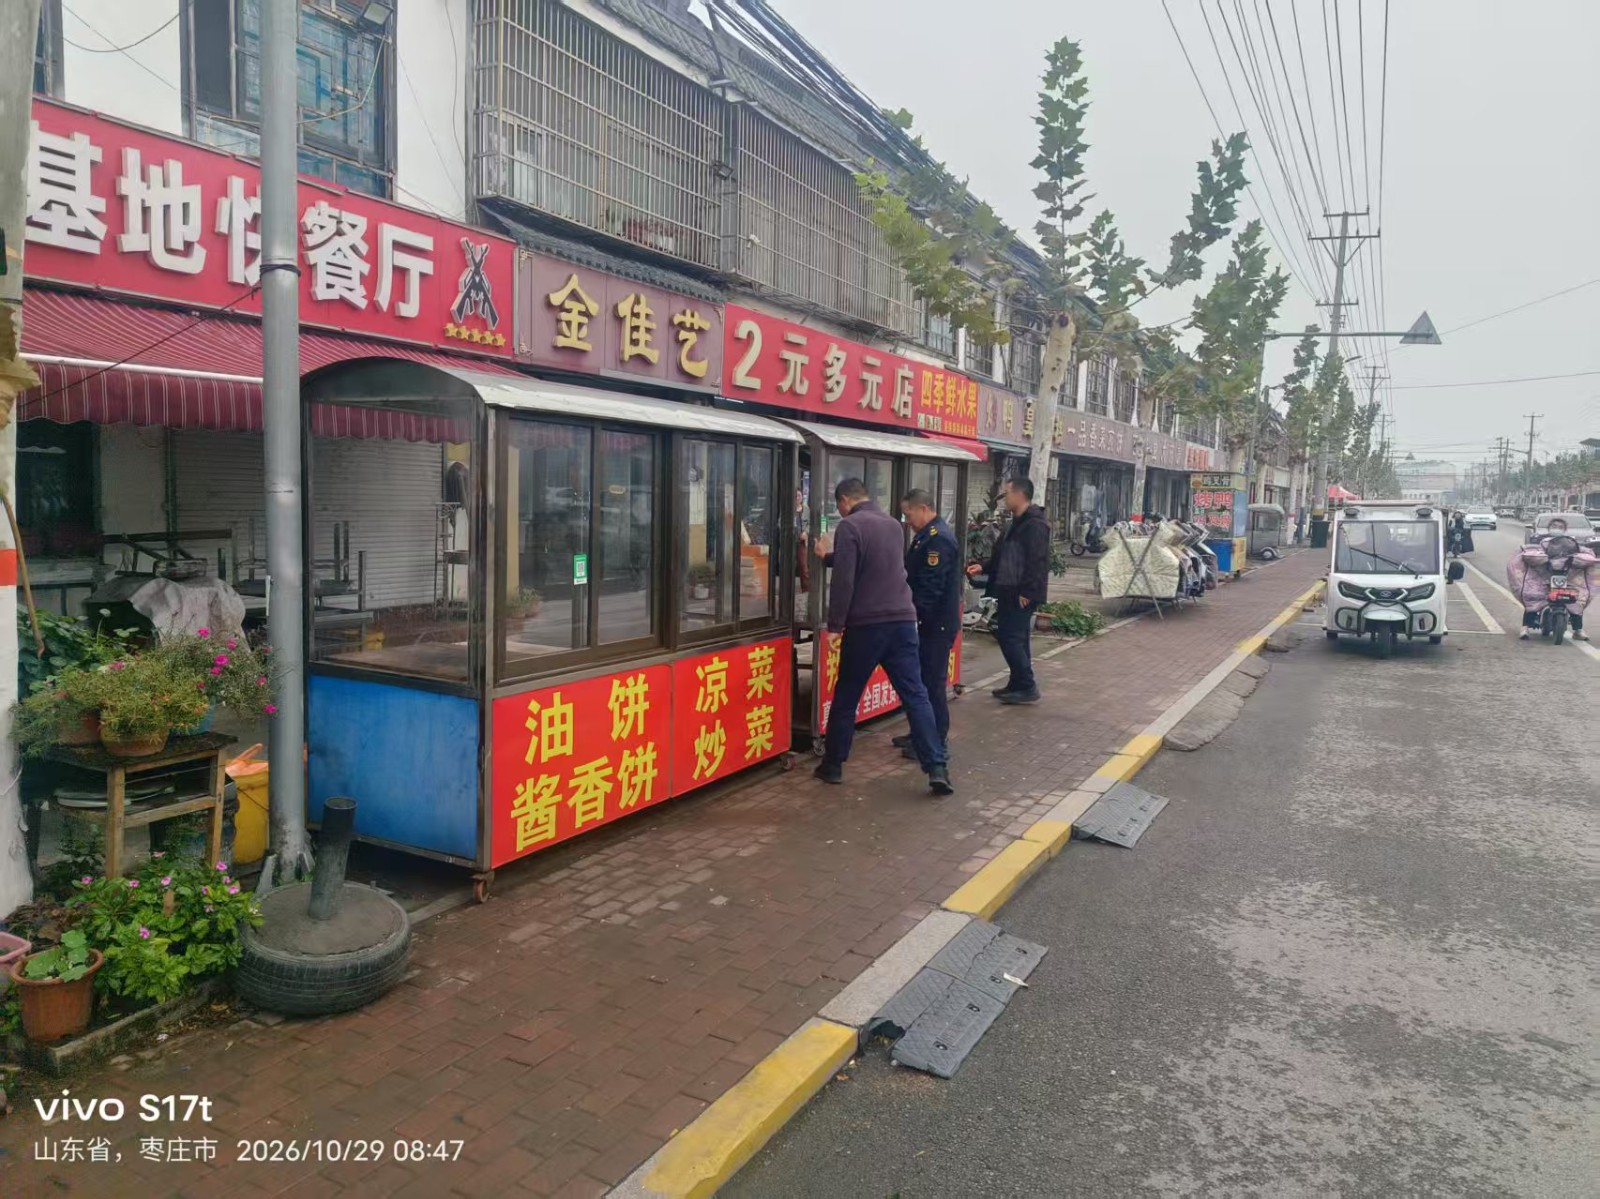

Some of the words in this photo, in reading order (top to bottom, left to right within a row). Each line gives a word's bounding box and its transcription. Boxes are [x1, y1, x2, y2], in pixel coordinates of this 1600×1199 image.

[547, 273, 711, 378] 金佳艺
[732, 320, 914, 418] 2元多元店
[921, 370, 977, 419] 四季鲜水果
[1193, 490, 1233, 509] 烤鸭
[525, 673, 650, 765] 油饼
[695, 645, 776, 714] 凉菜
[692, 704, 775, 781] 炒菜
[510, 742, 658, 852] 酱香饼
